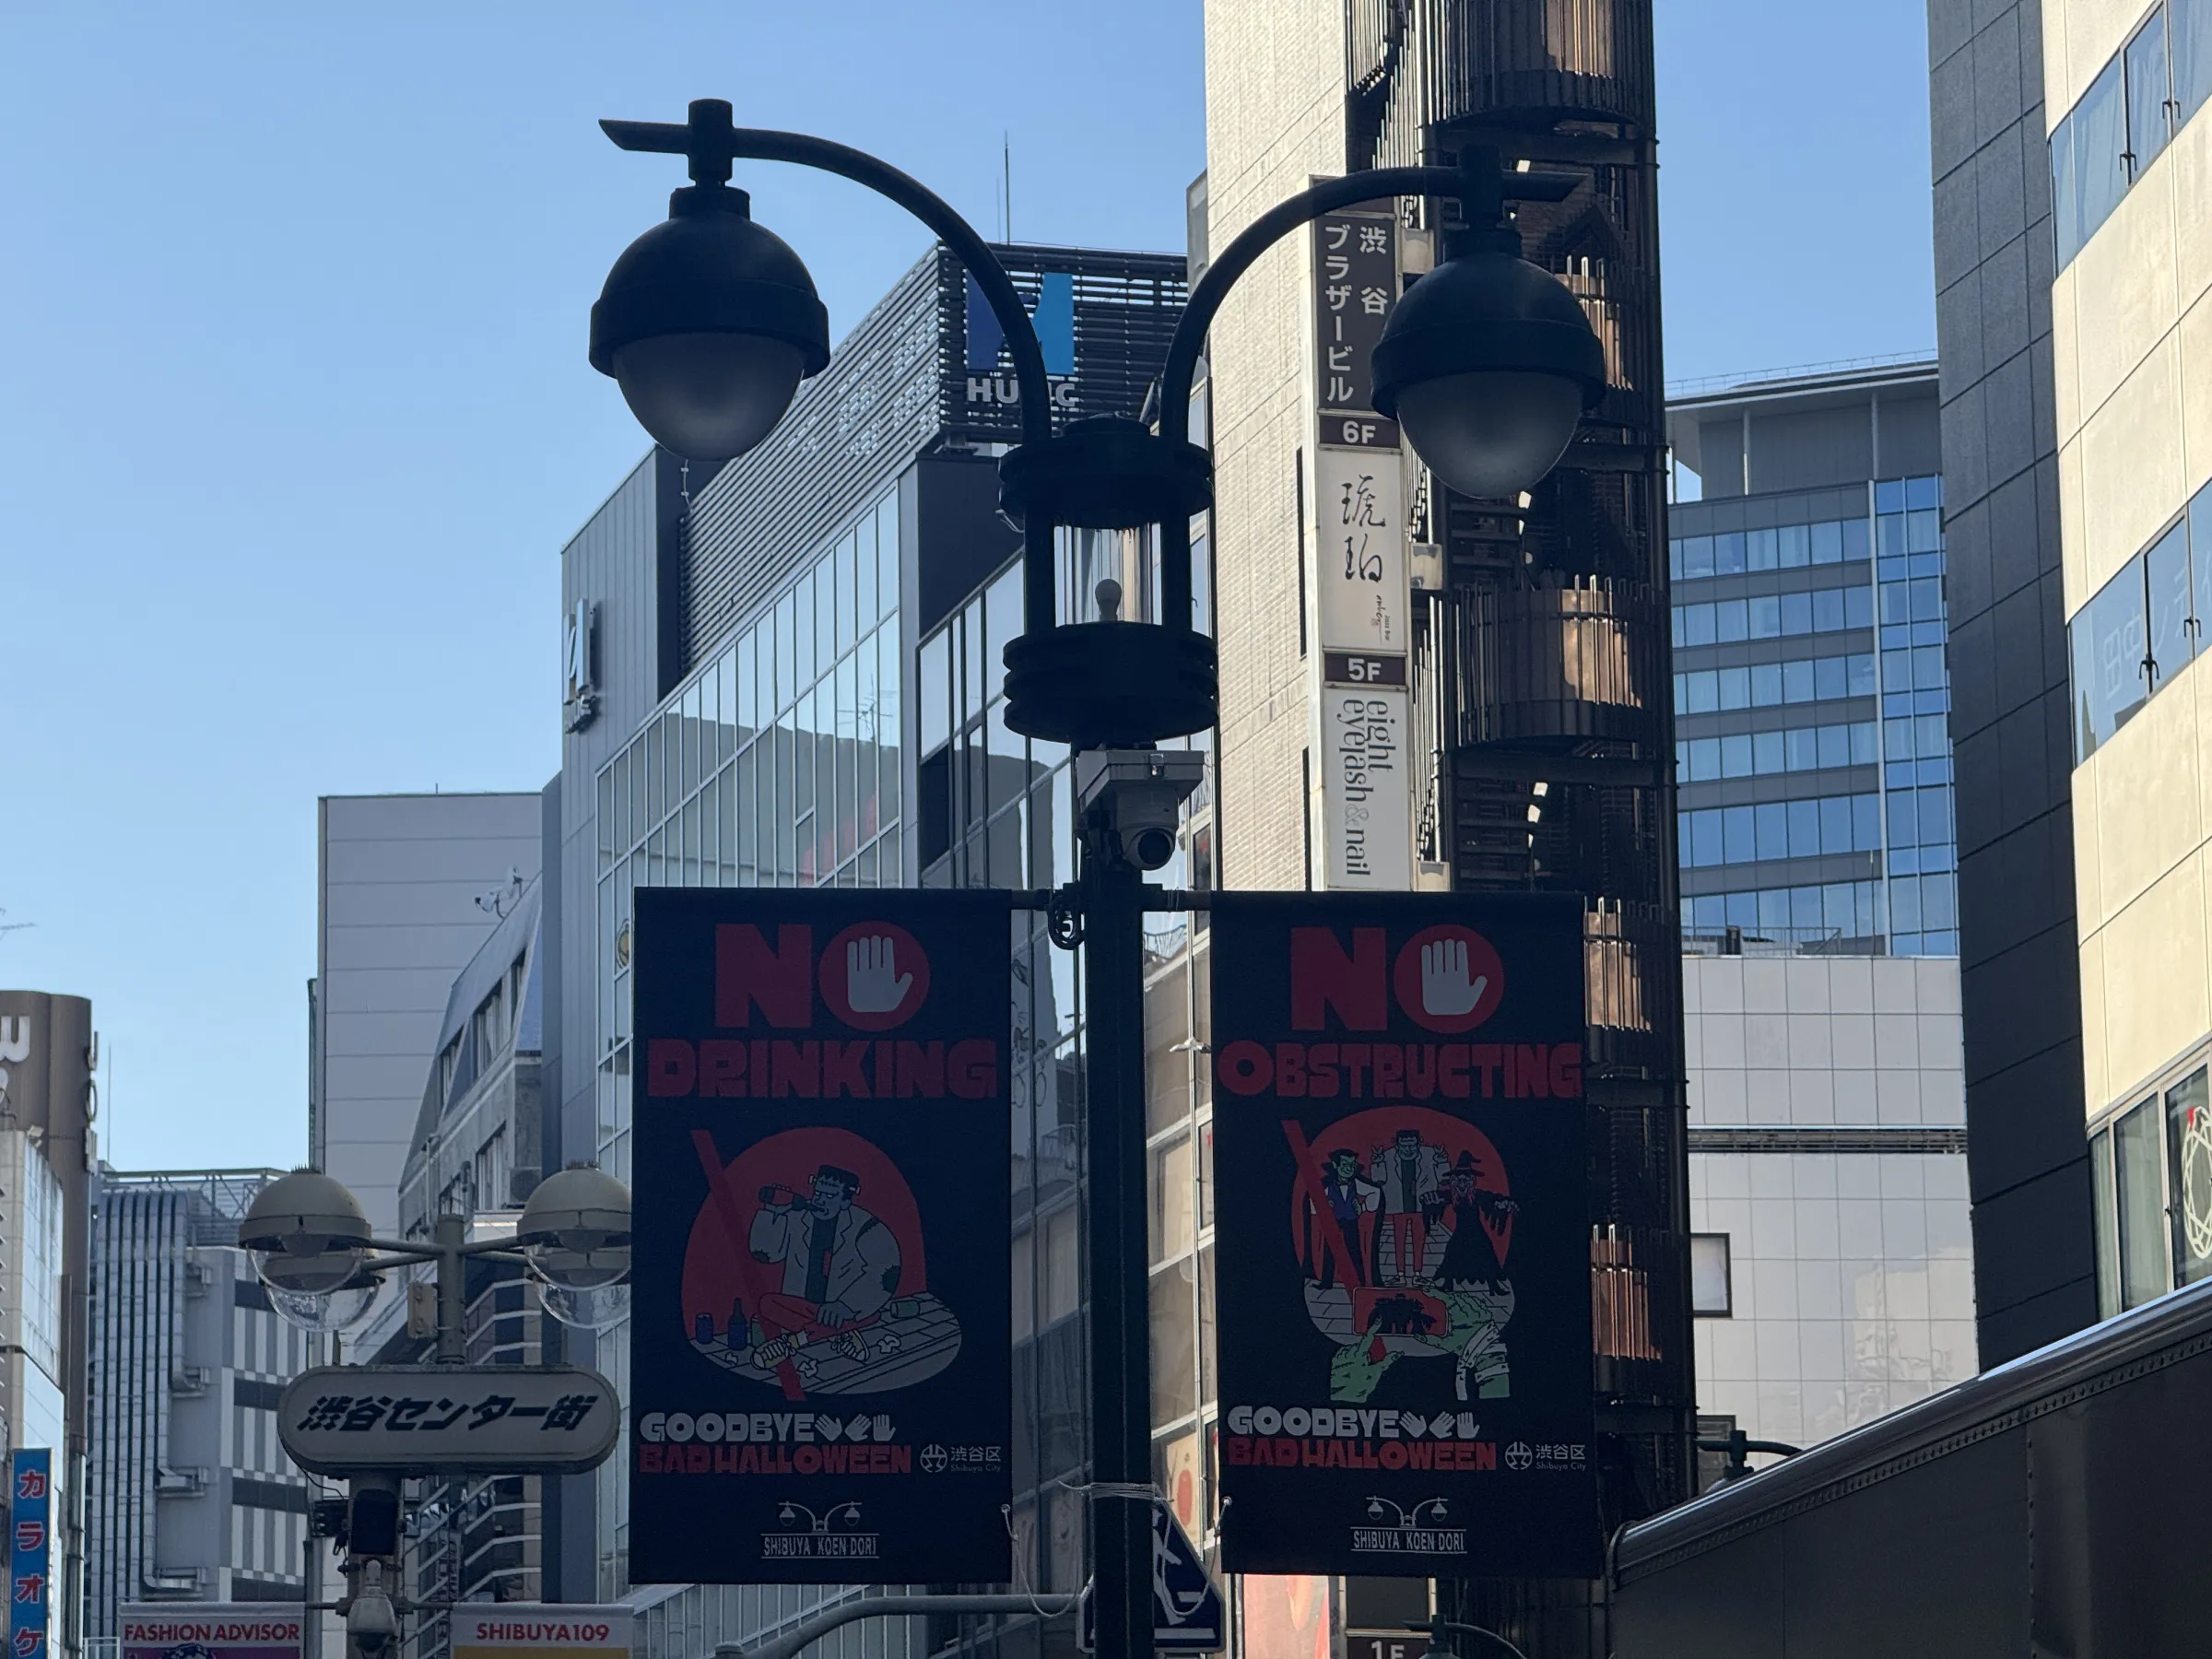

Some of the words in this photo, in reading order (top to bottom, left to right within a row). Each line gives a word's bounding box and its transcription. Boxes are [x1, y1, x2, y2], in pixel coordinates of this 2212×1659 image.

[1359, 226, 1388, 315] 渋谷
[1324, 224, 1354, 403] ブラザービル
[967, 377, 1076, 407] HUC
[1342, 420, 1376, 444] 6F
[1347, 657, 1382, 682] 5F
[1366, 700, 1396, 773] eight
[647, 1038, 998, 1100] DRINKING
[1217, 1040, 1583, 1100] OBSTRUCTING
[297, 1394, 599, 1431] 渋谷センター街
[1227, 1405, 1401, 1439] GOODBYE
[640, 1412, 815, 1442] GOODBYE
[950, 1445, 1002, 1463] 渋谷区
[1535, 1443, 1586, 1461] 渋谷区
[950, 1463, 983, 1474] Shibuya
[985, 1463, 1002, 1473] City
[1535, 1461, 1569, 1472] Shibuya
[1570, 1462, 1587, 1472] City
[763, 1535, 811, 1557] SHIBUYA
[817, 1536, 848, 1556] KOEN
[849, 1536, 877, 1556] DORI
[1353, 1530, 1401, 1550] SHIBUYA
[1406, 1531, 1435, 1551] KOEN
[1438, 1532, 1465, 1552] DORI
[14, 1469, 46, 1657] カラオケ
[124, 1623, 212, 1641] FASHION
[213, 1623, 300, 1641] ADVISOR
[476, 1621, 610, 1642] SHIBUYA109
[1370, 1640, 1406, 1659] 1F
